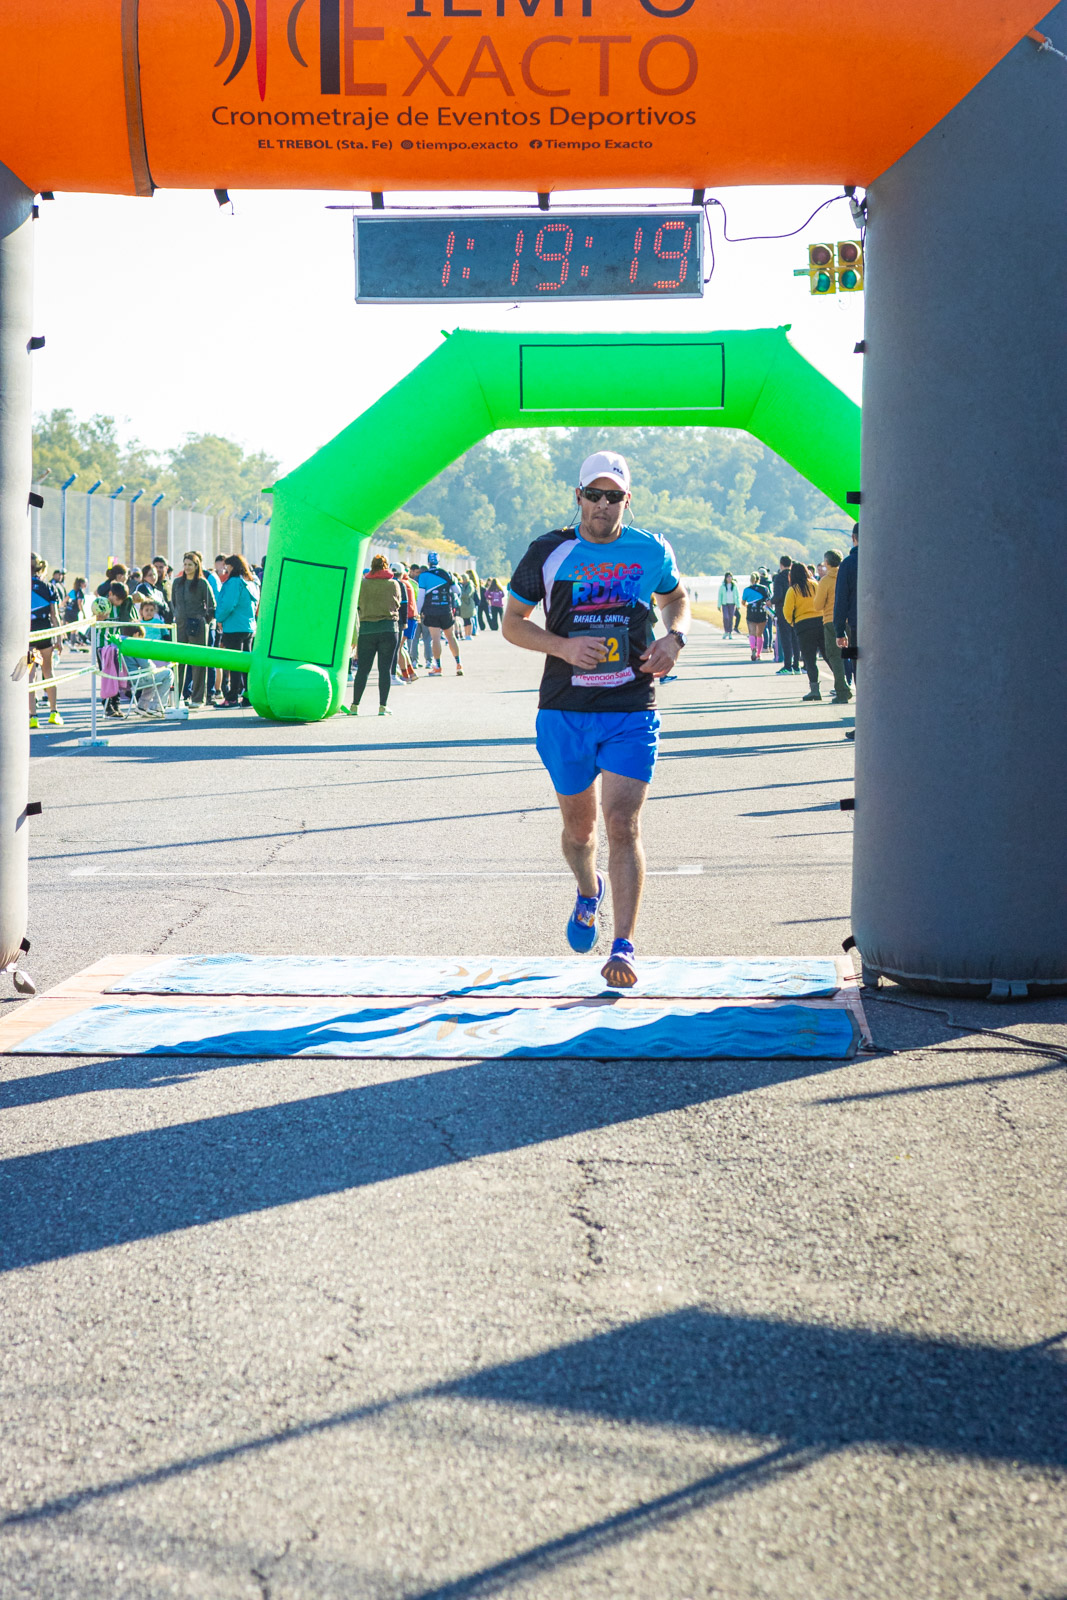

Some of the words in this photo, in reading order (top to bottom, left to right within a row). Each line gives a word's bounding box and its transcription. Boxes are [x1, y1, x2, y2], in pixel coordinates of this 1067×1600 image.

[344, 0, 698, 98] EXACTO
[212, 106, 389, 131] Cronometraje
[397, 106, 429, 126] de
[438, 107, 541, 126] Eventos
[550, 106, 697, 130] Deportivos
[258, 140, 275, 149] EL
[277, 139, 333, 149] TREBOL
[336, 139, 369, 150] (Sta.
[371, 139, 393, 150] Fe)
[416, 140, 519, 152] tiempo.exacto
[545, 139, 601, 151] Tiempo
[605, 140, 653, 150] Exacto
[573, 614, 603, 624] RAFAELA,
[604, 615, 624, 623] SANTA
